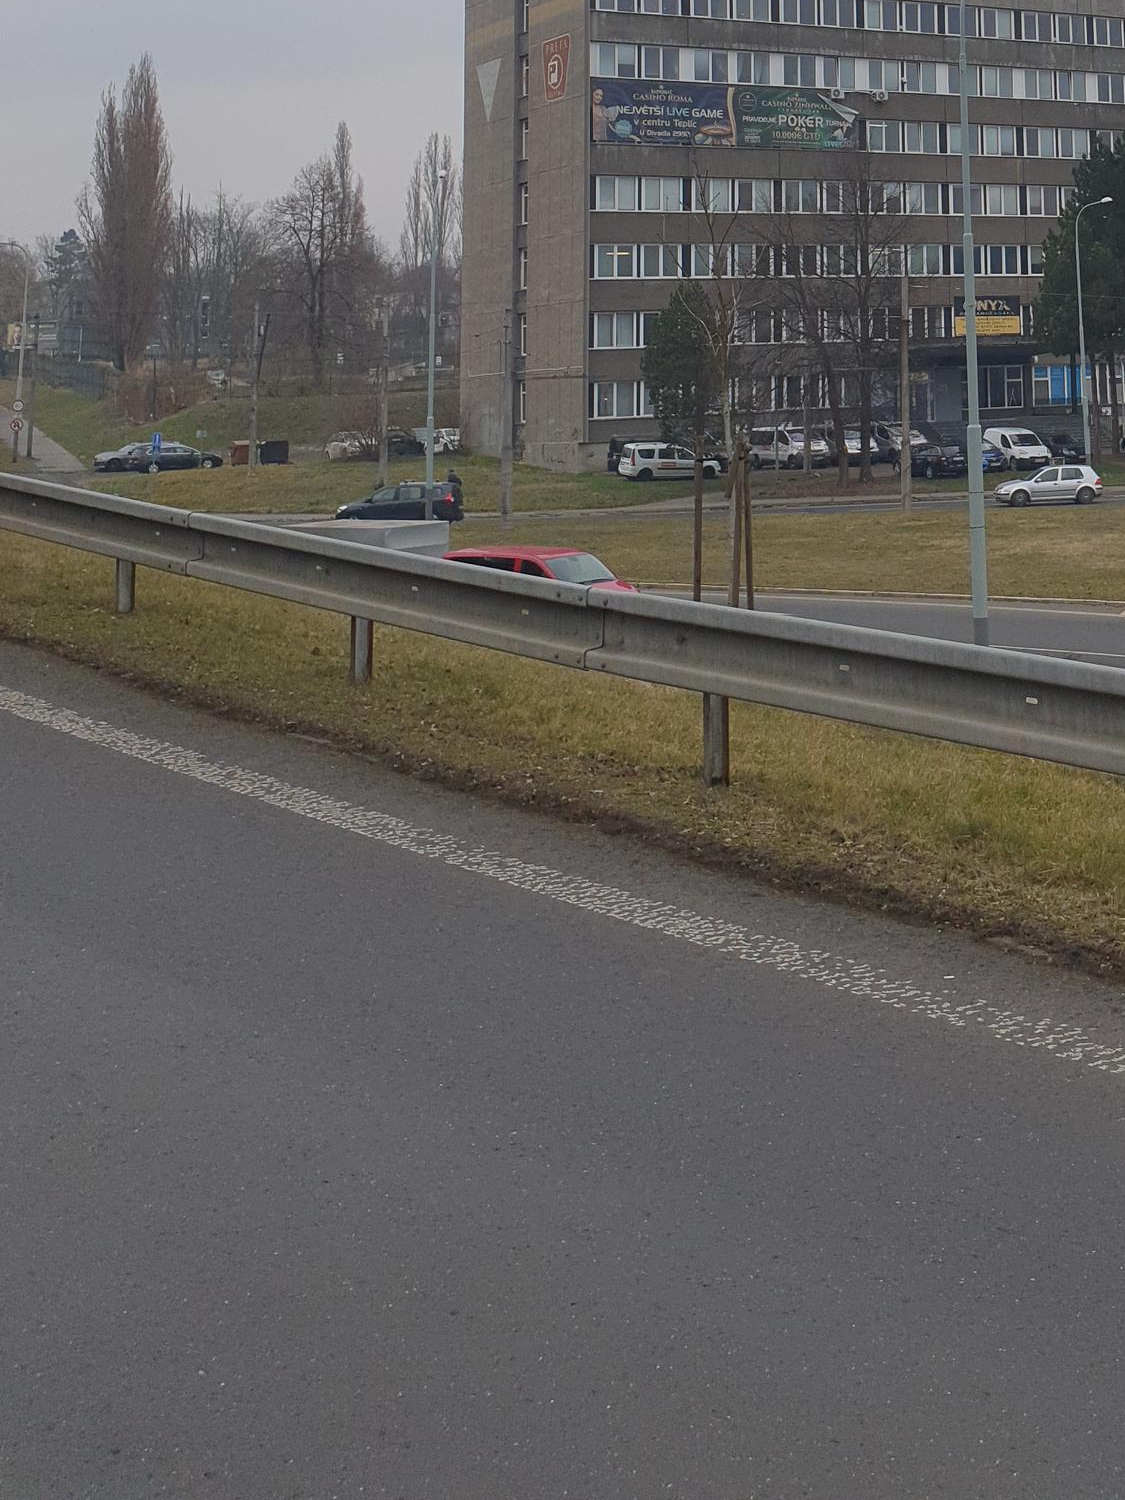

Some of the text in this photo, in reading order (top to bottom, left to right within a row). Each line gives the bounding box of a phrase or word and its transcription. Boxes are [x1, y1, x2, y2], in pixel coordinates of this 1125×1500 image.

[633, 93, 693, 104] CASINO ROMA
[761, 100, 792, 108] CASINO
[794, 101, 832, 111] ZINNWAL
[667, 106, 690, 117] LIVE
[692, 108, 724, 118] GAME
[642, 119, 671, 127] centru
[673, 120, 697, 129] Teplic
[778, 114, 824, 128] POKER
[963, 300, 1010, 311] NYX
